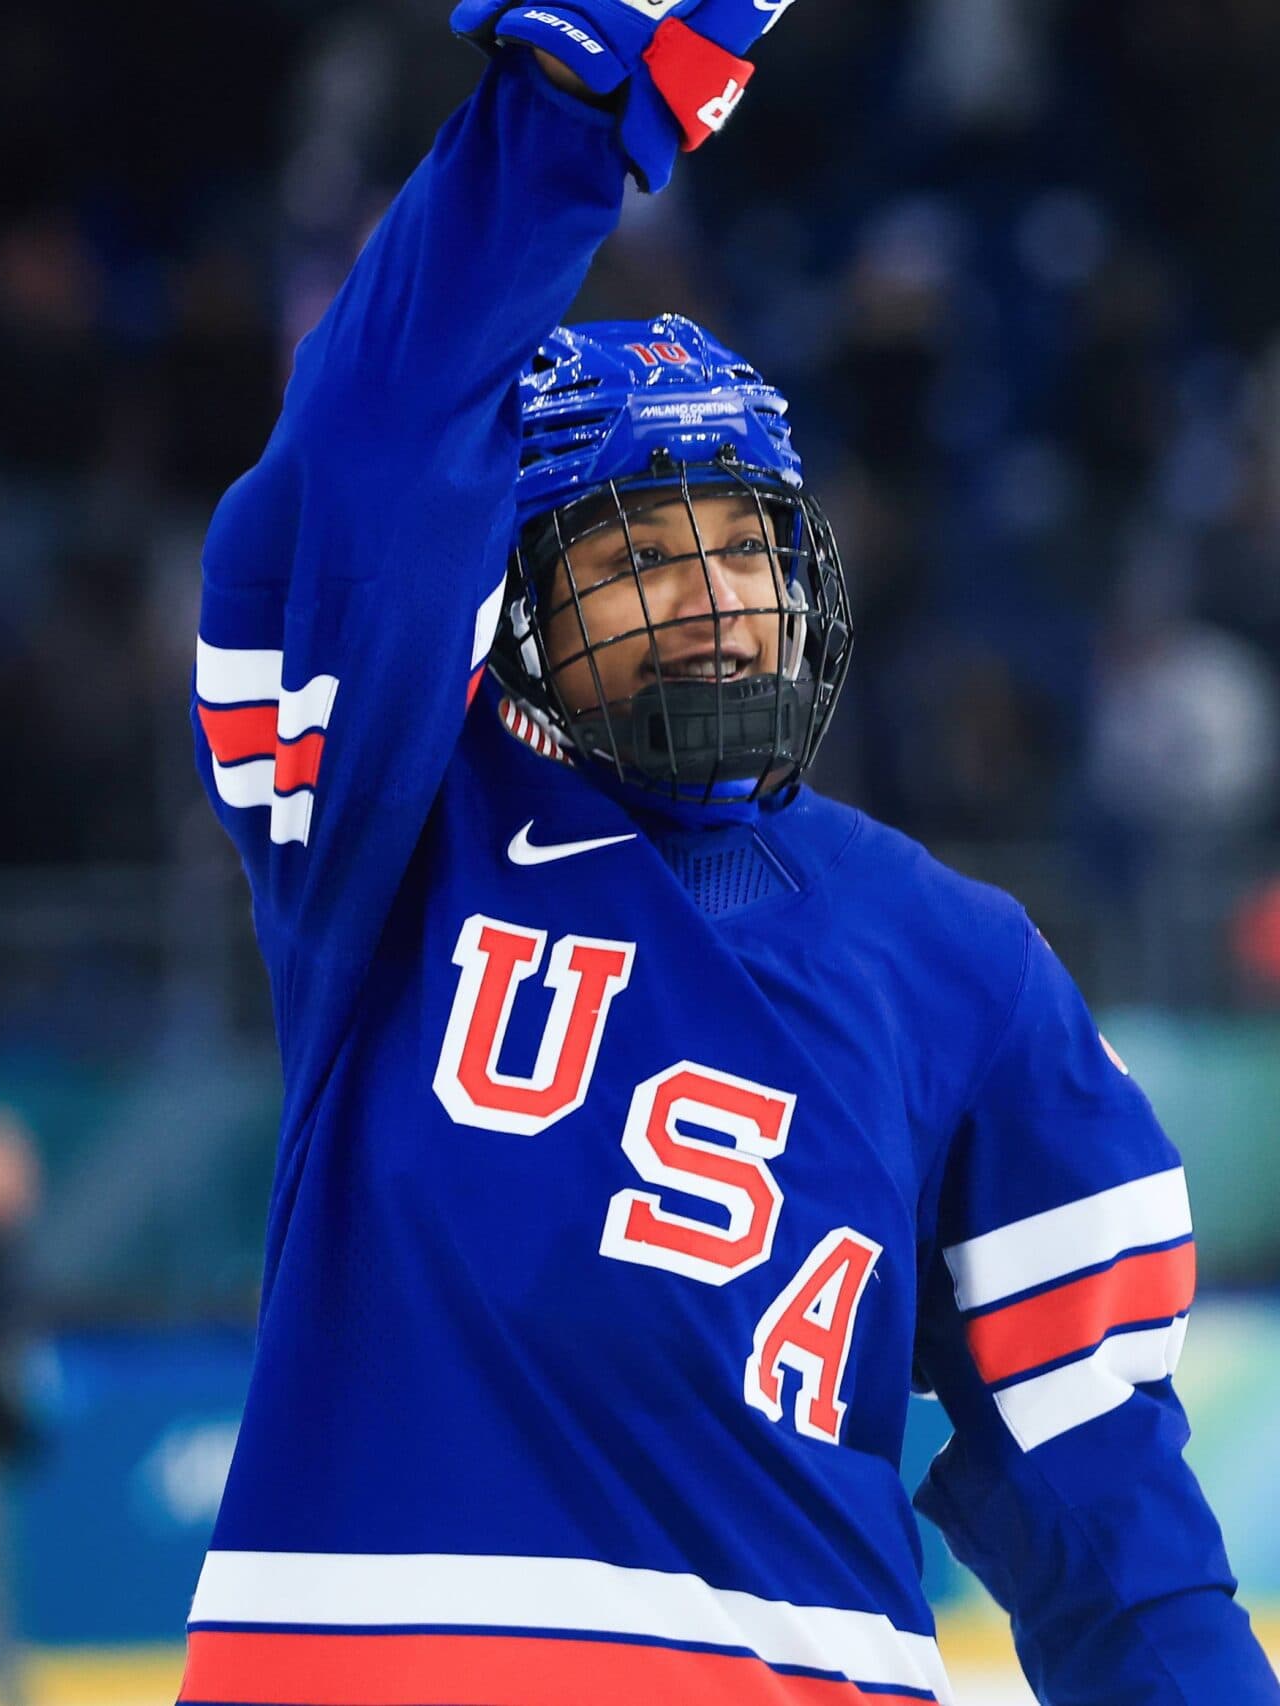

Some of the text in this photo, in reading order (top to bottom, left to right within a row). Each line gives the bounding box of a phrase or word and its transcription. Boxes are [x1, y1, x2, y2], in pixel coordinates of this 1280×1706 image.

[523, 10, 605, 54] BAUER
[624, 342, 691, 366] 10
[640, 404, 688, 418] MILANO
[432, 913, 883, 1446] USA
